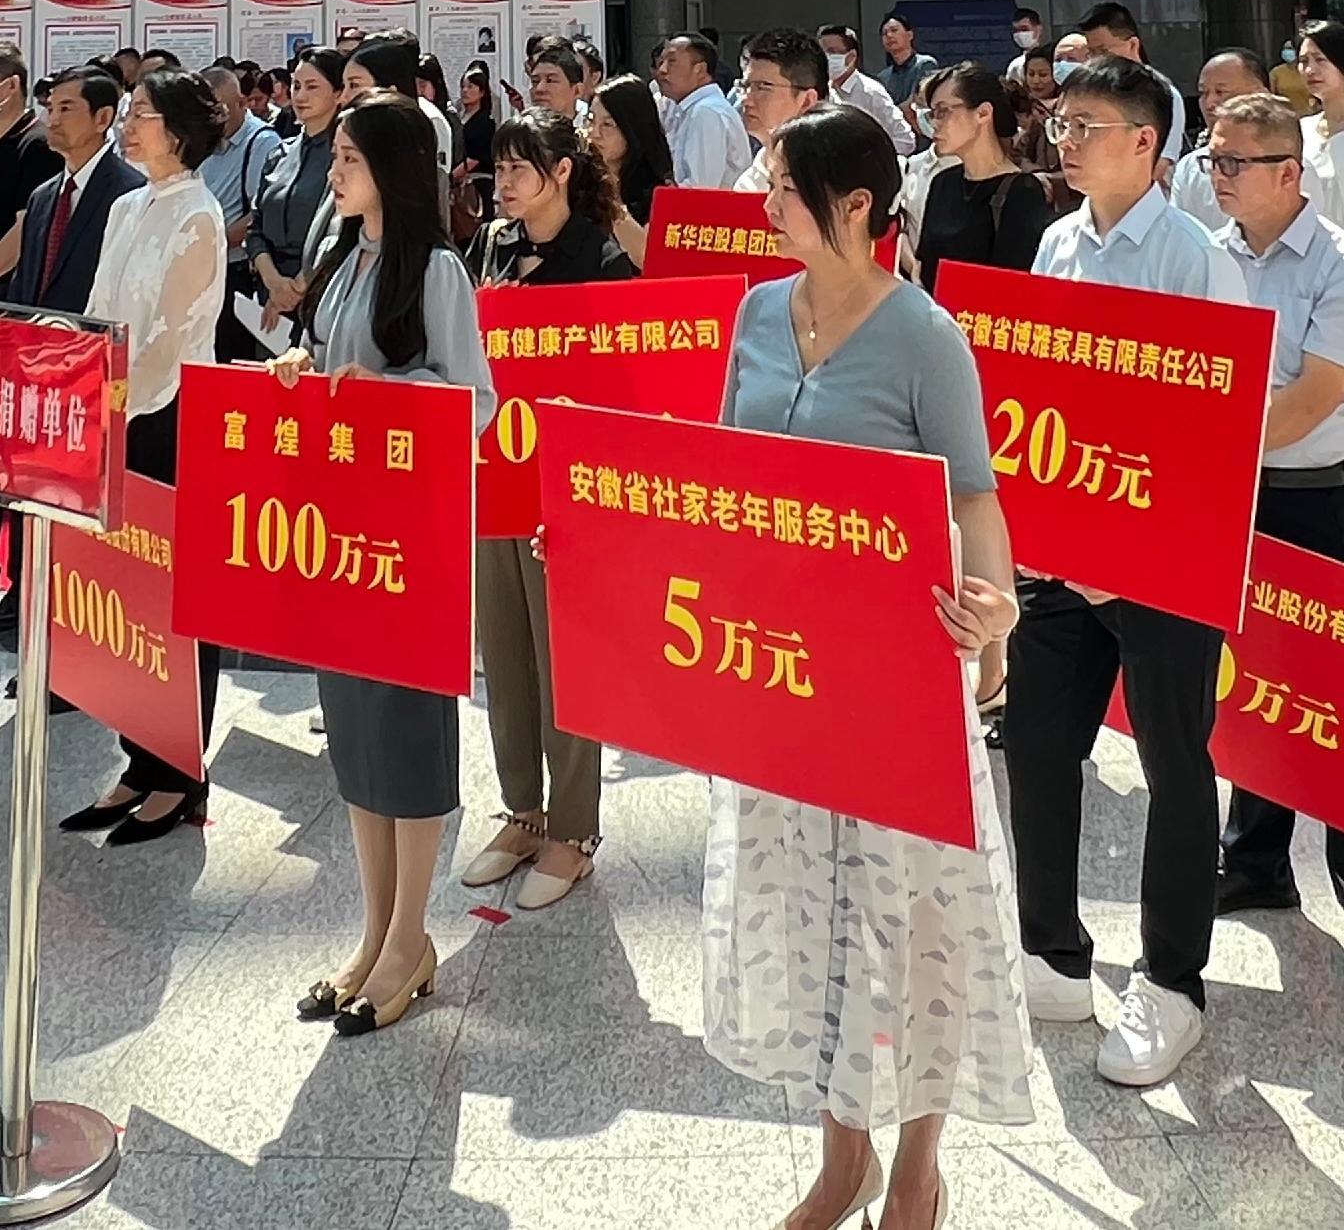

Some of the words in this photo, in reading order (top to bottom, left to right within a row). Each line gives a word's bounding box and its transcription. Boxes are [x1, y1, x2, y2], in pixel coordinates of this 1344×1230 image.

[479, 319, 721, 360] 康健康产业有限公司
[956, 310, 1234, 395] 安徽省博雅家具有限责任公司
[224, 411, 415, 472] 富煌集团
[992, 398, 1154, 510] 20万元
[224, 493, 406, 595] 100万元
[569, 462, 909, 563] 安徽省社家老年服务中心
[52, 562, 169, 682] 1000万元
[663, 576, 815, 699] 5万元
